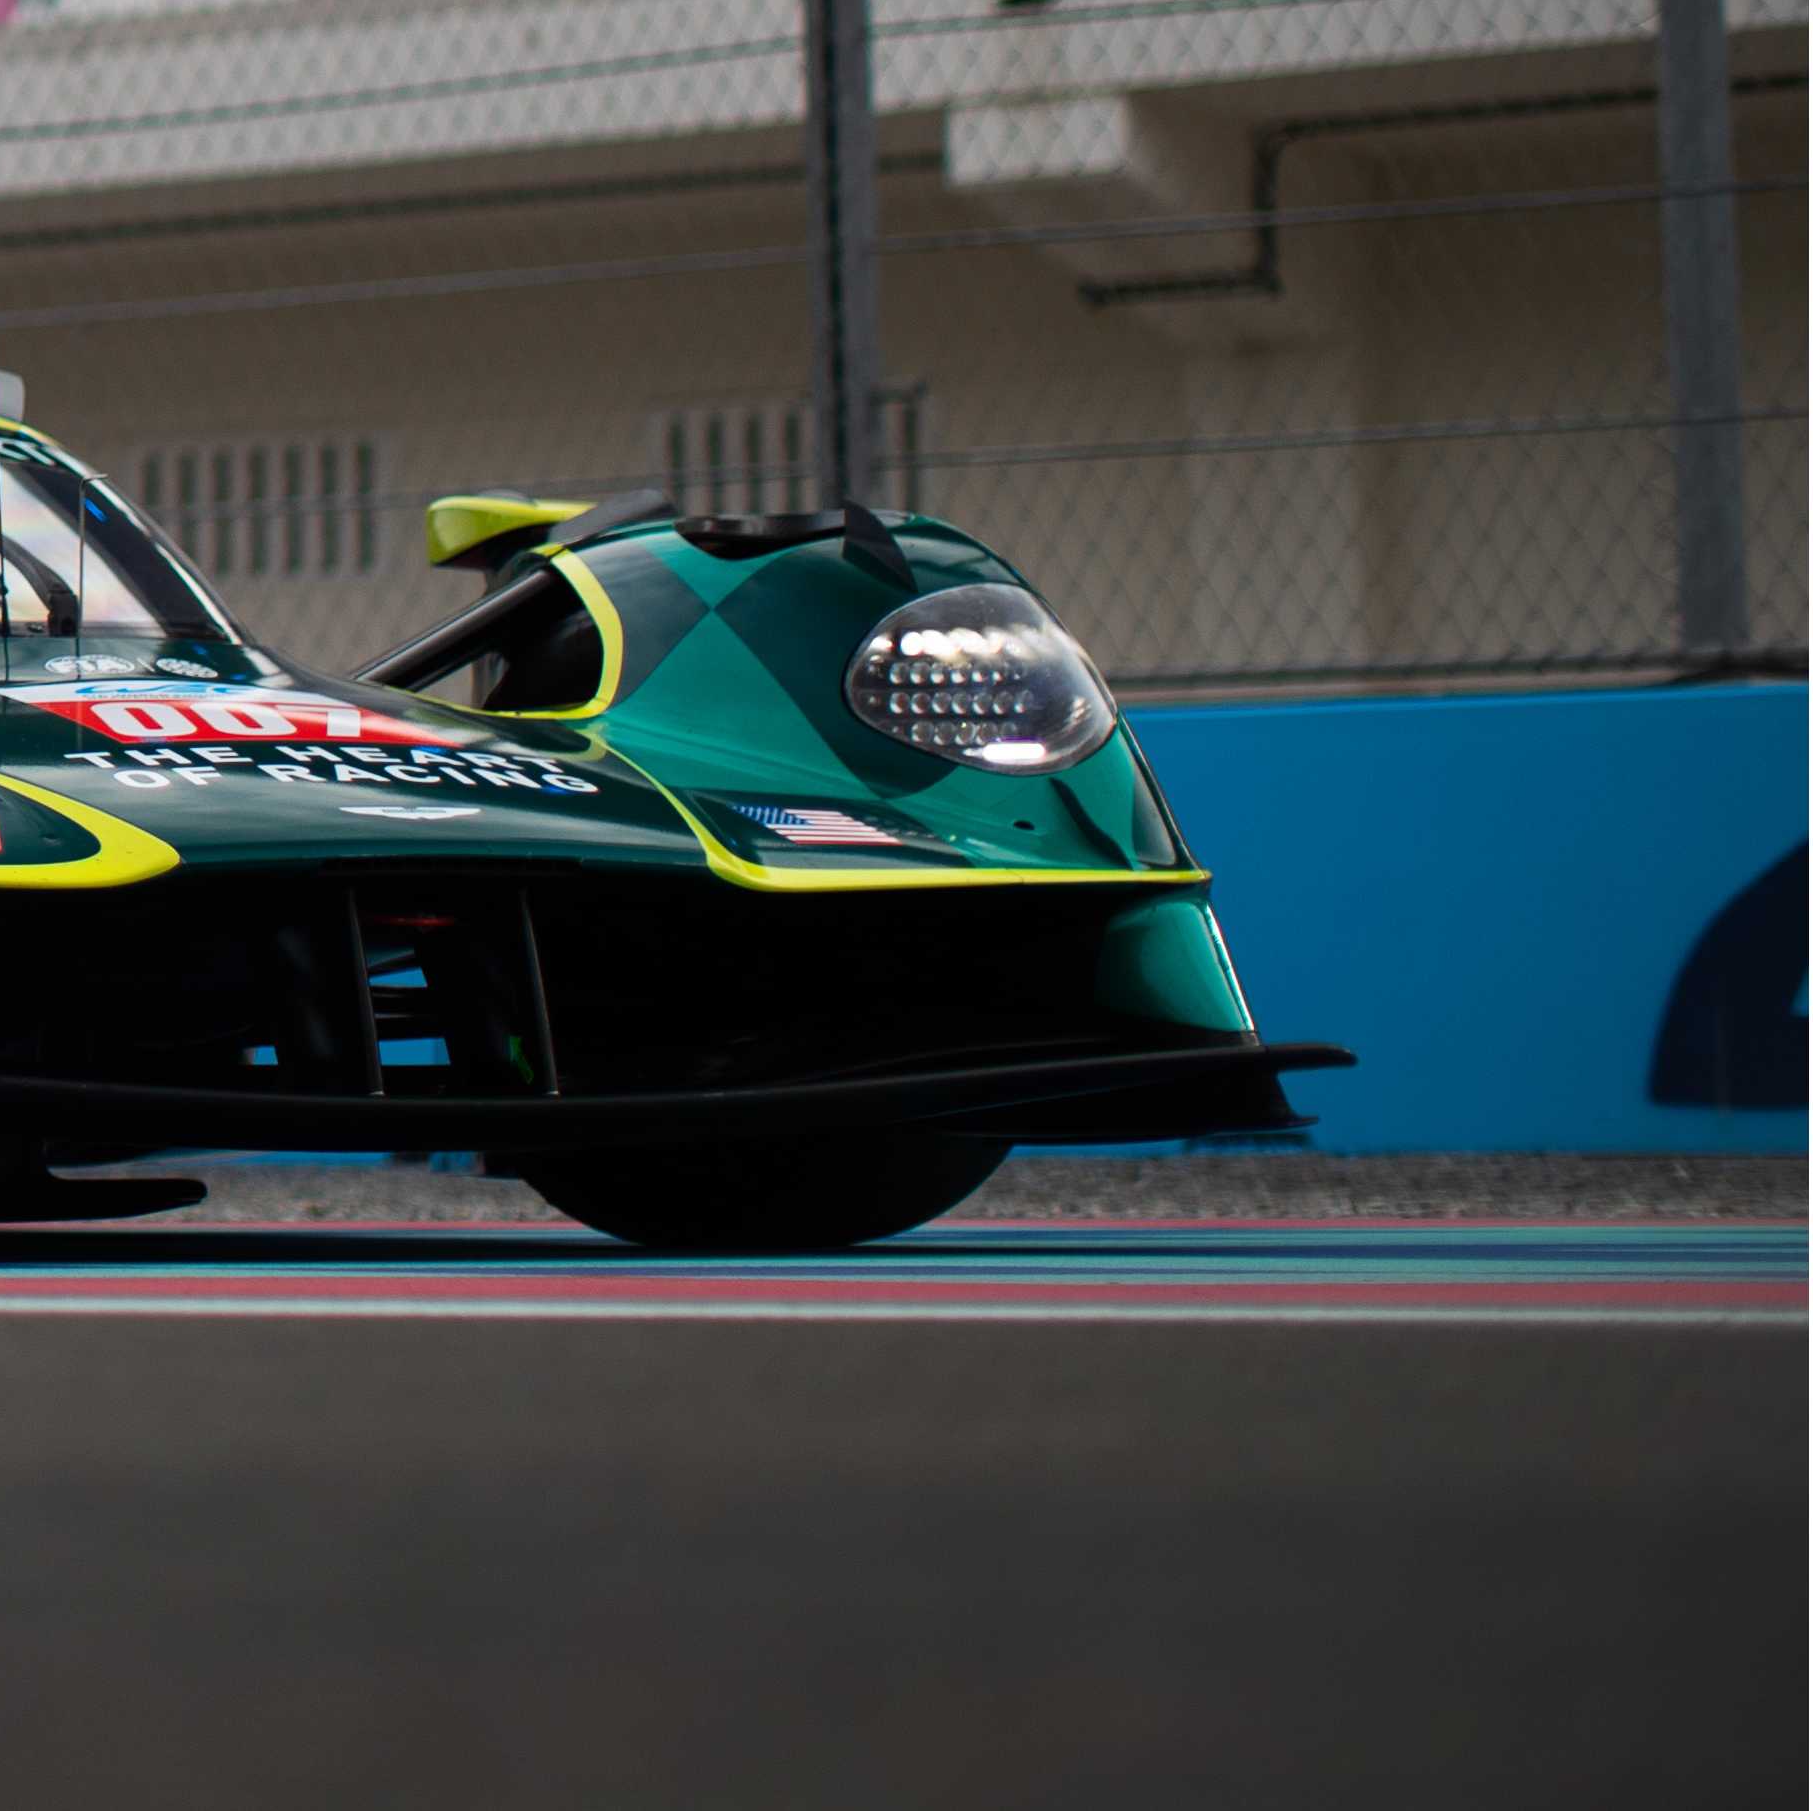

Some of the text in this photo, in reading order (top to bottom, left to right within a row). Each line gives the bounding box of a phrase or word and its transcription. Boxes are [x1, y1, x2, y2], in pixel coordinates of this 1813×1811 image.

[90, 701, 362, 738] 007
[64, 746, 565, 773] THE HEART
[113, 764, 599, 793] OF RACING
